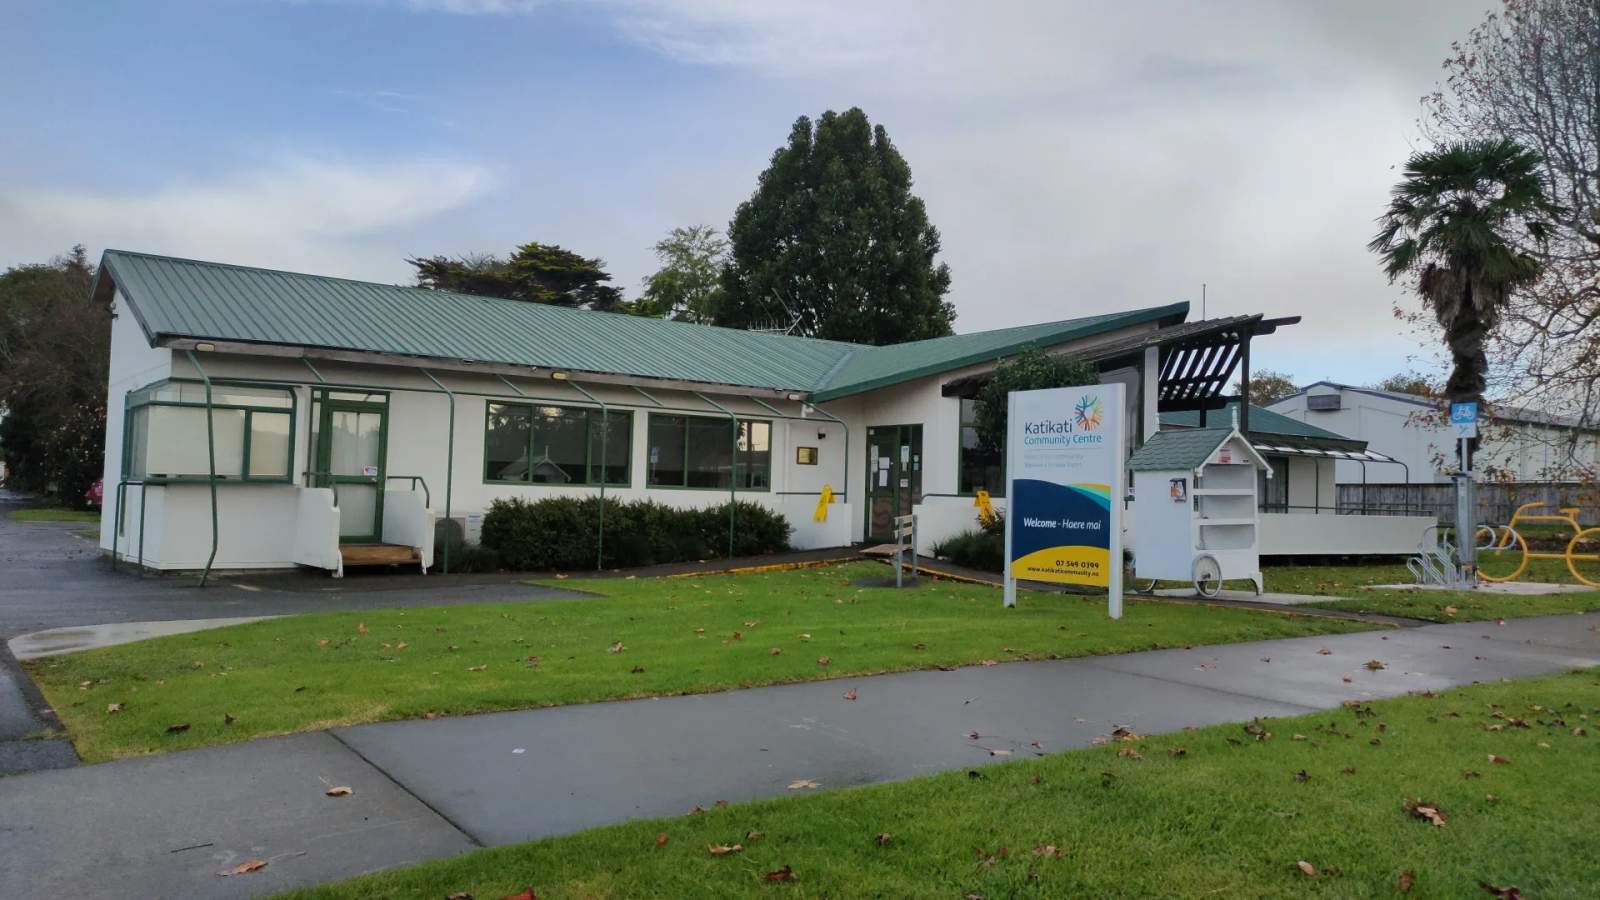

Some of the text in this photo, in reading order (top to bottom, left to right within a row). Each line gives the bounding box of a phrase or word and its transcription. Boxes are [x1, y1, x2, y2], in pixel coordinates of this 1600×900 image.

[1024, 418, 1072, 434] Katikati
[1024, 434, 1102, 446] Community Centre
[1023, 517, 1057, 528] Welcome
[1062, 519, 1085, 529] Haere
[1086, 520, 1102, 530] mai
